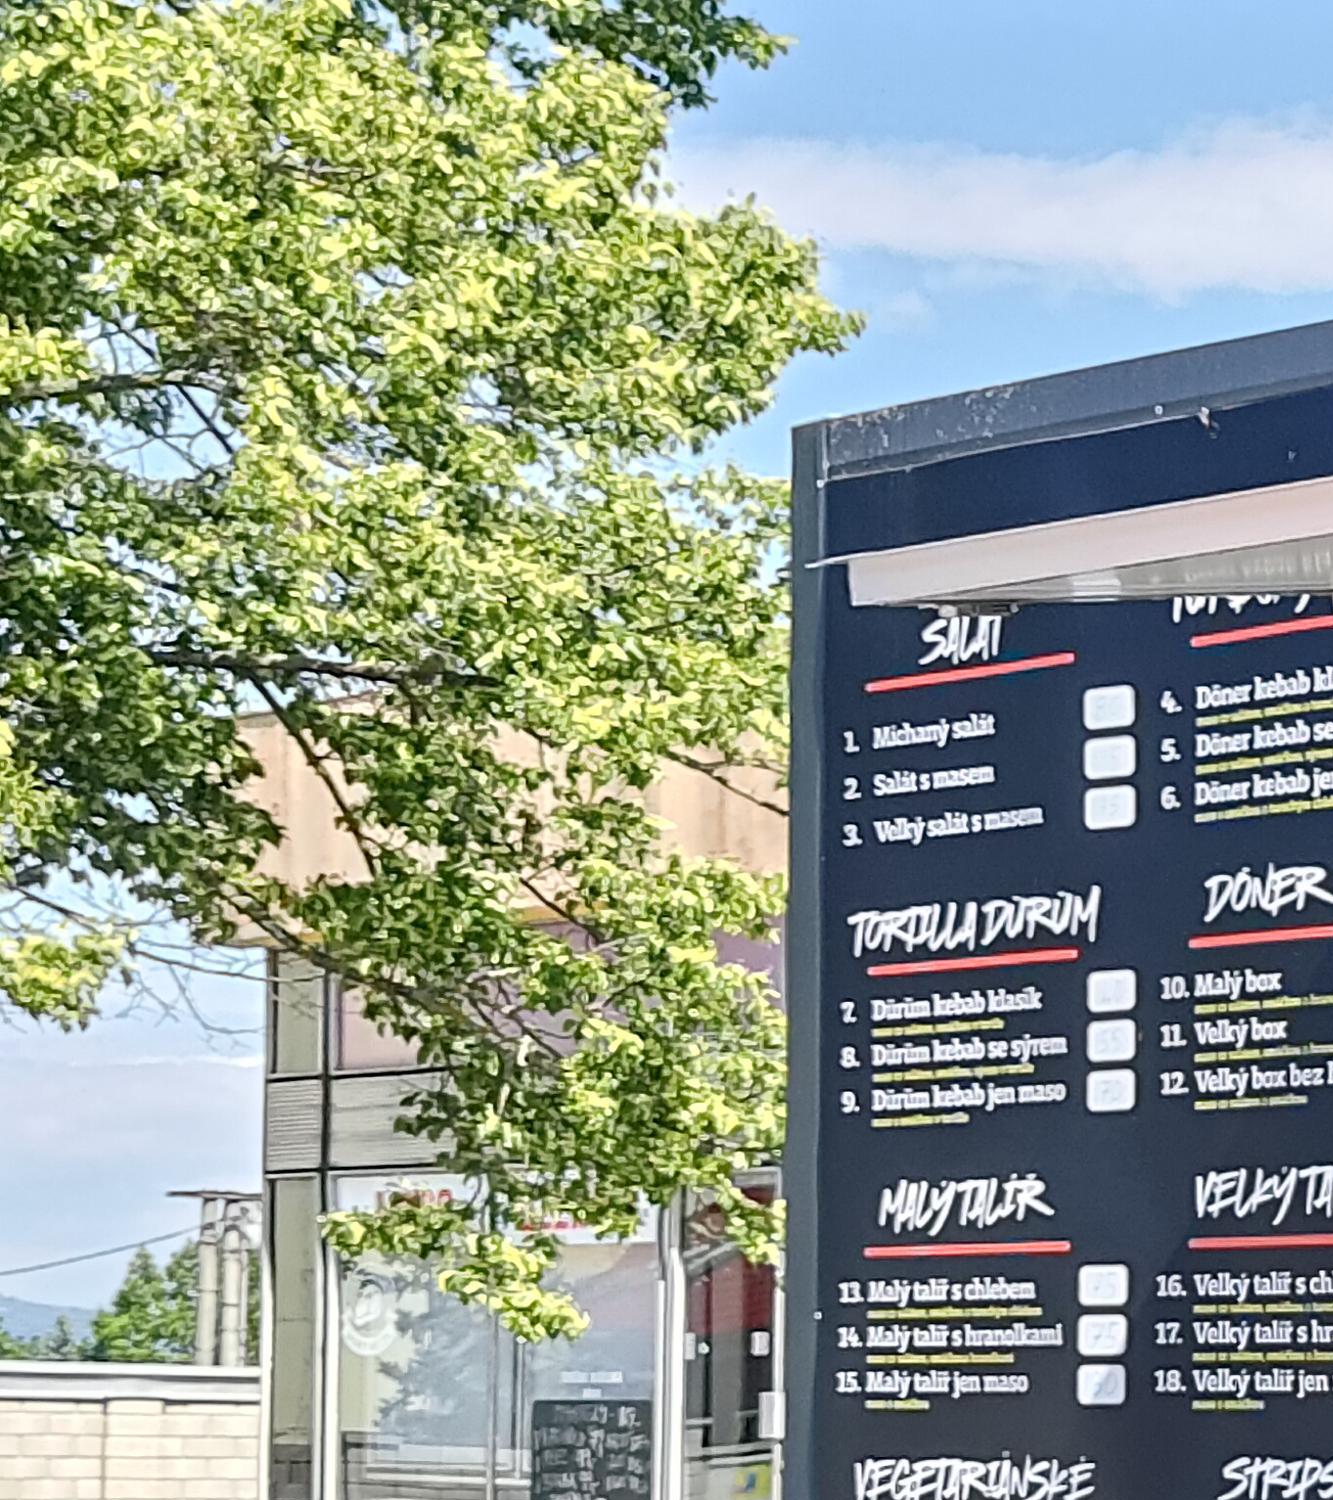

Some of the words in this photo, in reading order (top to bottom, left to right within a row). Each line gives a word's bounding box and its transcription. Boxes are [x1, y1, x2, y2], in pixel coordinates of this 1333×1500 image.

[1196, 682, 1252, 709] Döner
[1253, 670, 1311, 700] kebab
[1160, 739, 1181, 762] 5.
[1195, 731, 1252, 757] Döner
[1252, 720, 1310, 749] kebab
[1160, 786, 1181, 810] 6.
[1194, 781, 1249, 806] Döner
[1252, 769, 1310, 799] kebab
[847, 902, 978, 958] TORTILLA
[1160, 976, 1190, 1000] 10.
[1194, 971, 1242, 999] Malý
[1245, 968, 1282, 991] box
[988, 1039, 1008, 1057] se
[1194, 1019, 1248, 1048] Velký
[1250, 1017, 1288, 1040] box
[1194, 1067, 1249, 1097] Velký
[1250, 1065, 1288, 1089] box
[1288, 1063, 1324, 1086] bez
[1156, 1275, 1187, 1297] 16.
[1193, 1272, 1250, 1303] Velký
[1254, 1271, 1292, 1295] talíř
[1295, 1277, 1307, 1295] s
[1155, 1322, 1183, 1344] 17.
[1193, 1320, 1250, 1351] Velký
[1254, 1319, 1292, 1343] talíř
[1296, 1325, 1308, 1343] s
[1154, 1369, 1187, 1392] 18.
[1192, 1368, 1250, 1398] Velký
[1254, 1368, 1292, 1391] talíř
[1297, 1370, 1330, 1398] jen
